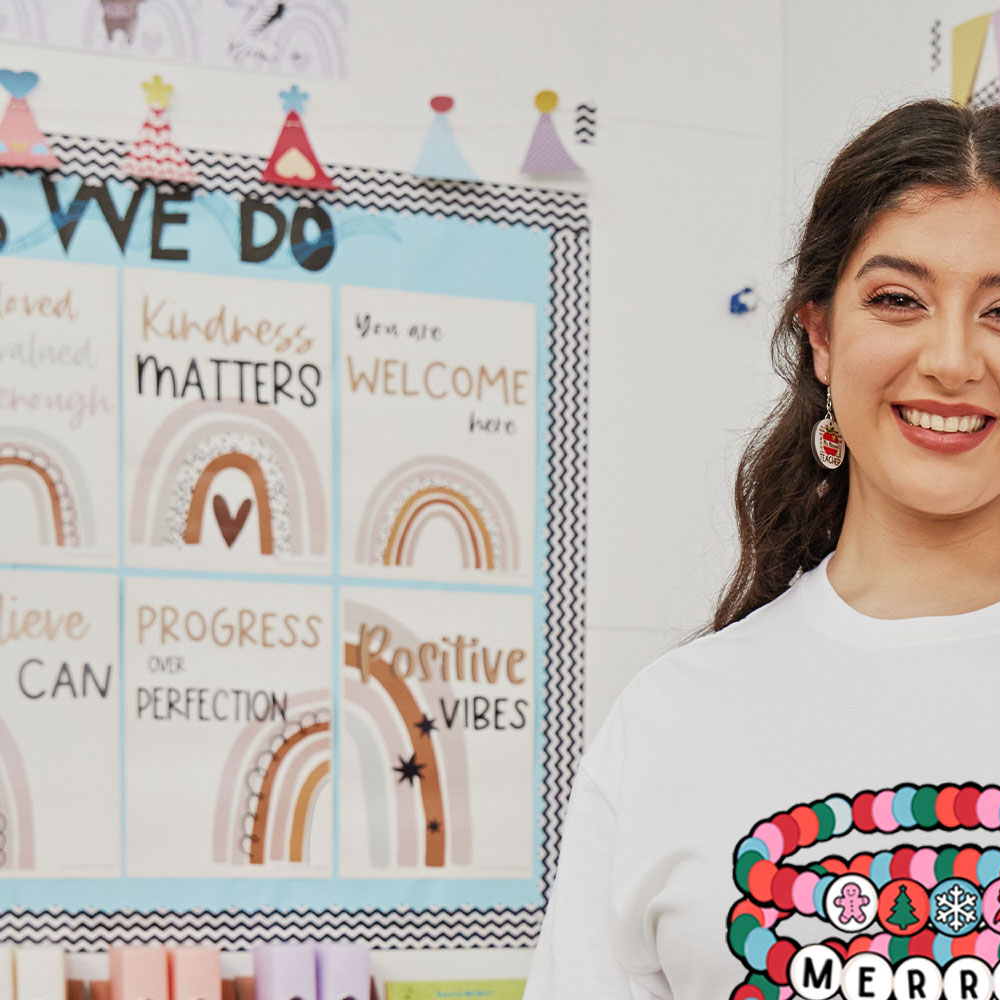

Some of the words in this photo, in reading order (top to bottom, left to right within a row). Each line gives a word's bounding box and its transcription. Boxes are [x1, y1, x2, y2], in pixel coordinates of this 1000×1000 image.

[41, 173, 192, 261] WE
[240, 195, 335, 271] DO
[142, 295, 316, 353] Kindness
[355, 312, 399, 339] You
[408, 324, 442, 342] are
[136, 354, 322, 408] MATTERS
[346, 354, 530, 406] WELCOME
[468, 410, 517, 435] here
[138, 605, 323, 647] PROGRESS
[148, 655, 186, 673] OVER
[359, 623, 527, 685] Positive
[19, 658, 112, 700] CAN
[136, 687, 288, 722] PERFECTION
[440, 696, 528, 730] VIBES
